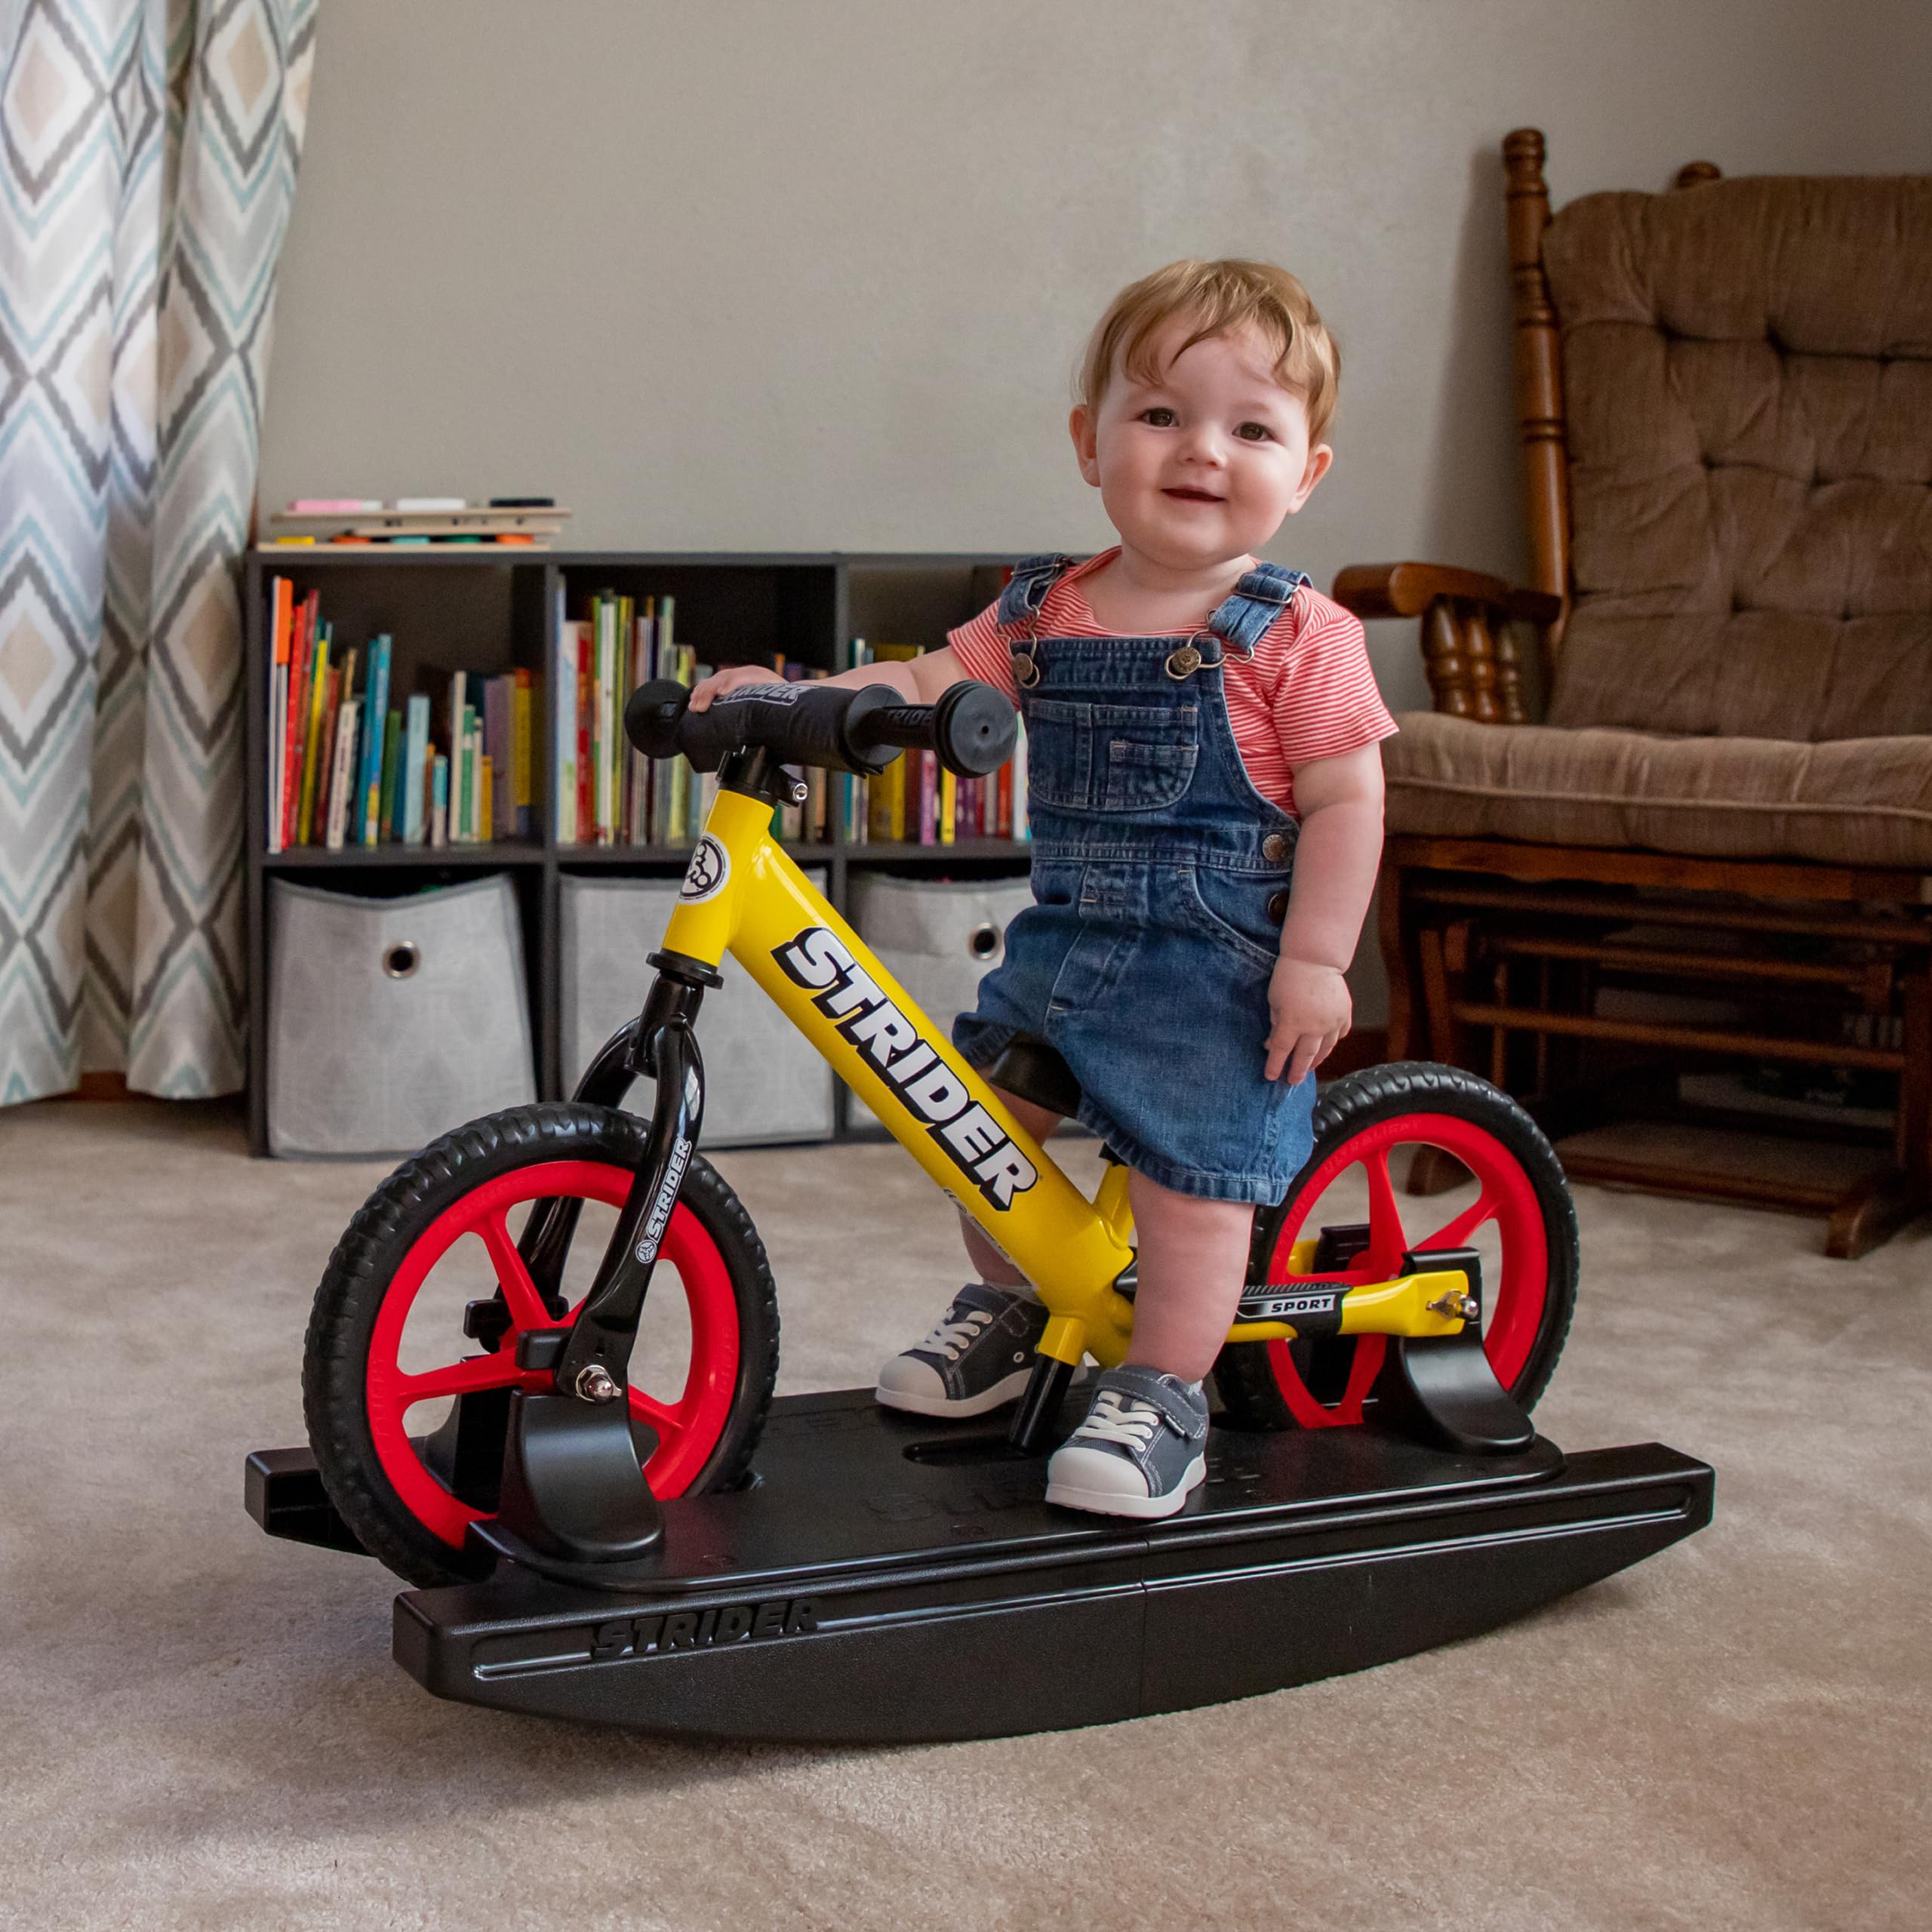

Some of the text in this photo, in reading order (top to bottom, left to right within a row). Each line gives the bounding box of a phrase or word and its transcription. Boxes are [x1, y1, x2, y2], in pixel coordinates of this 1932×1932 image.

[771, 928, 1038, 1211] STRIDER
[647, 1137, 692, 1243] STRIDER
[1271, 1298, 1331, 1313] SPORT
[592, 1598, 818, 1658] STRIDER
